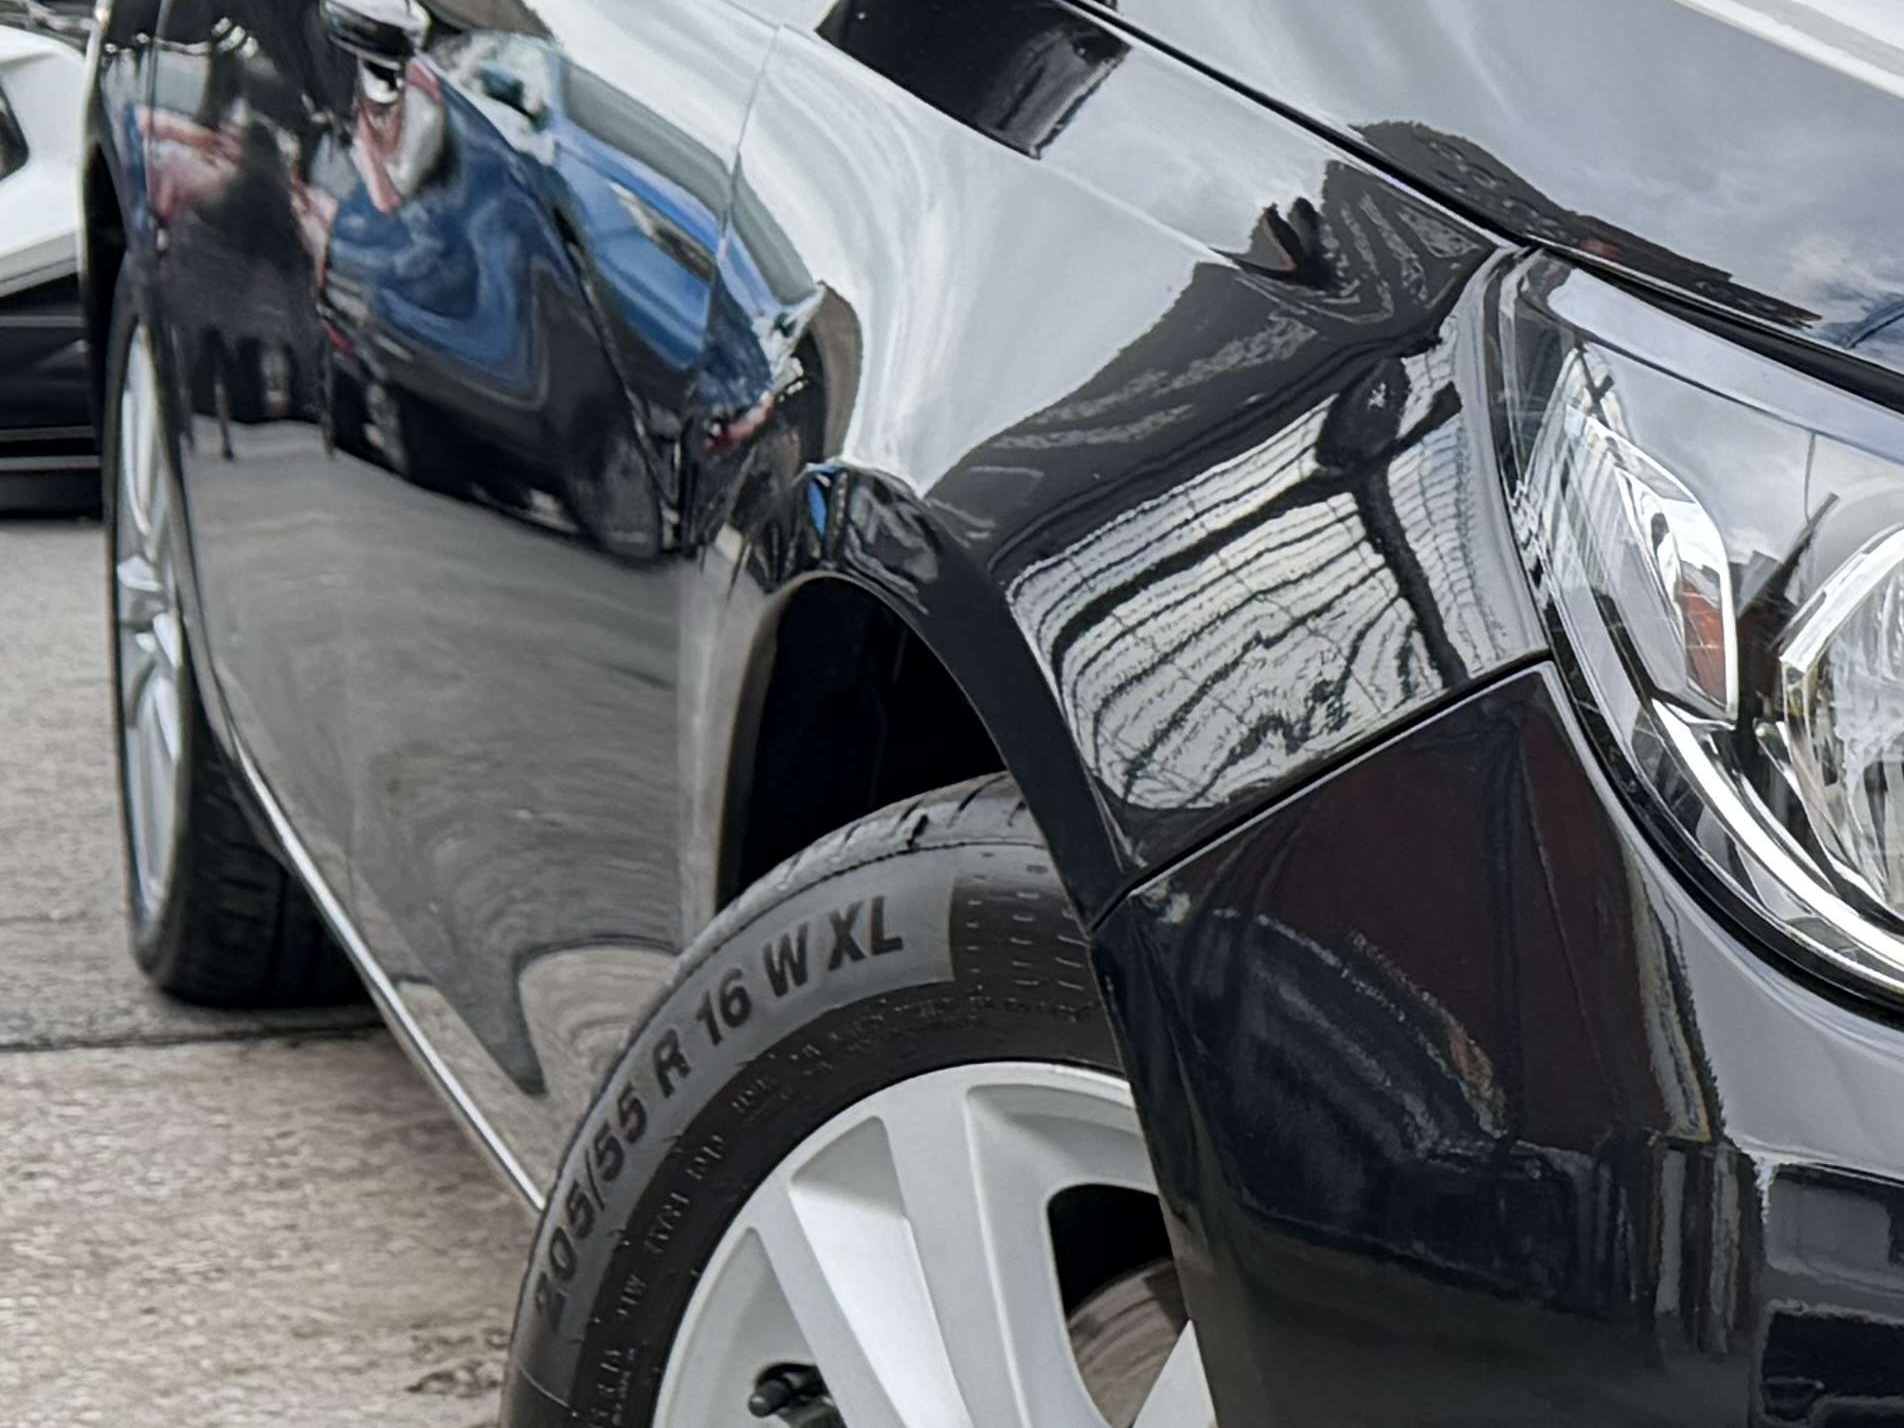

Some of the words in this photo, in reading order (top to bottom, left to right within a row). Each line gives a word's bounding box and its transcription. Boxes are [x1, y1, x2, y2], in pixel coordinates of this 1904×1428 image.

[534, 1080, 650, 1334] 205/55
[651, 1028, 693, 1100] R
[696, 968, 753, 1047] 16
[760, 924, 812, 999] W
[827, 895, 904, 972] XL
